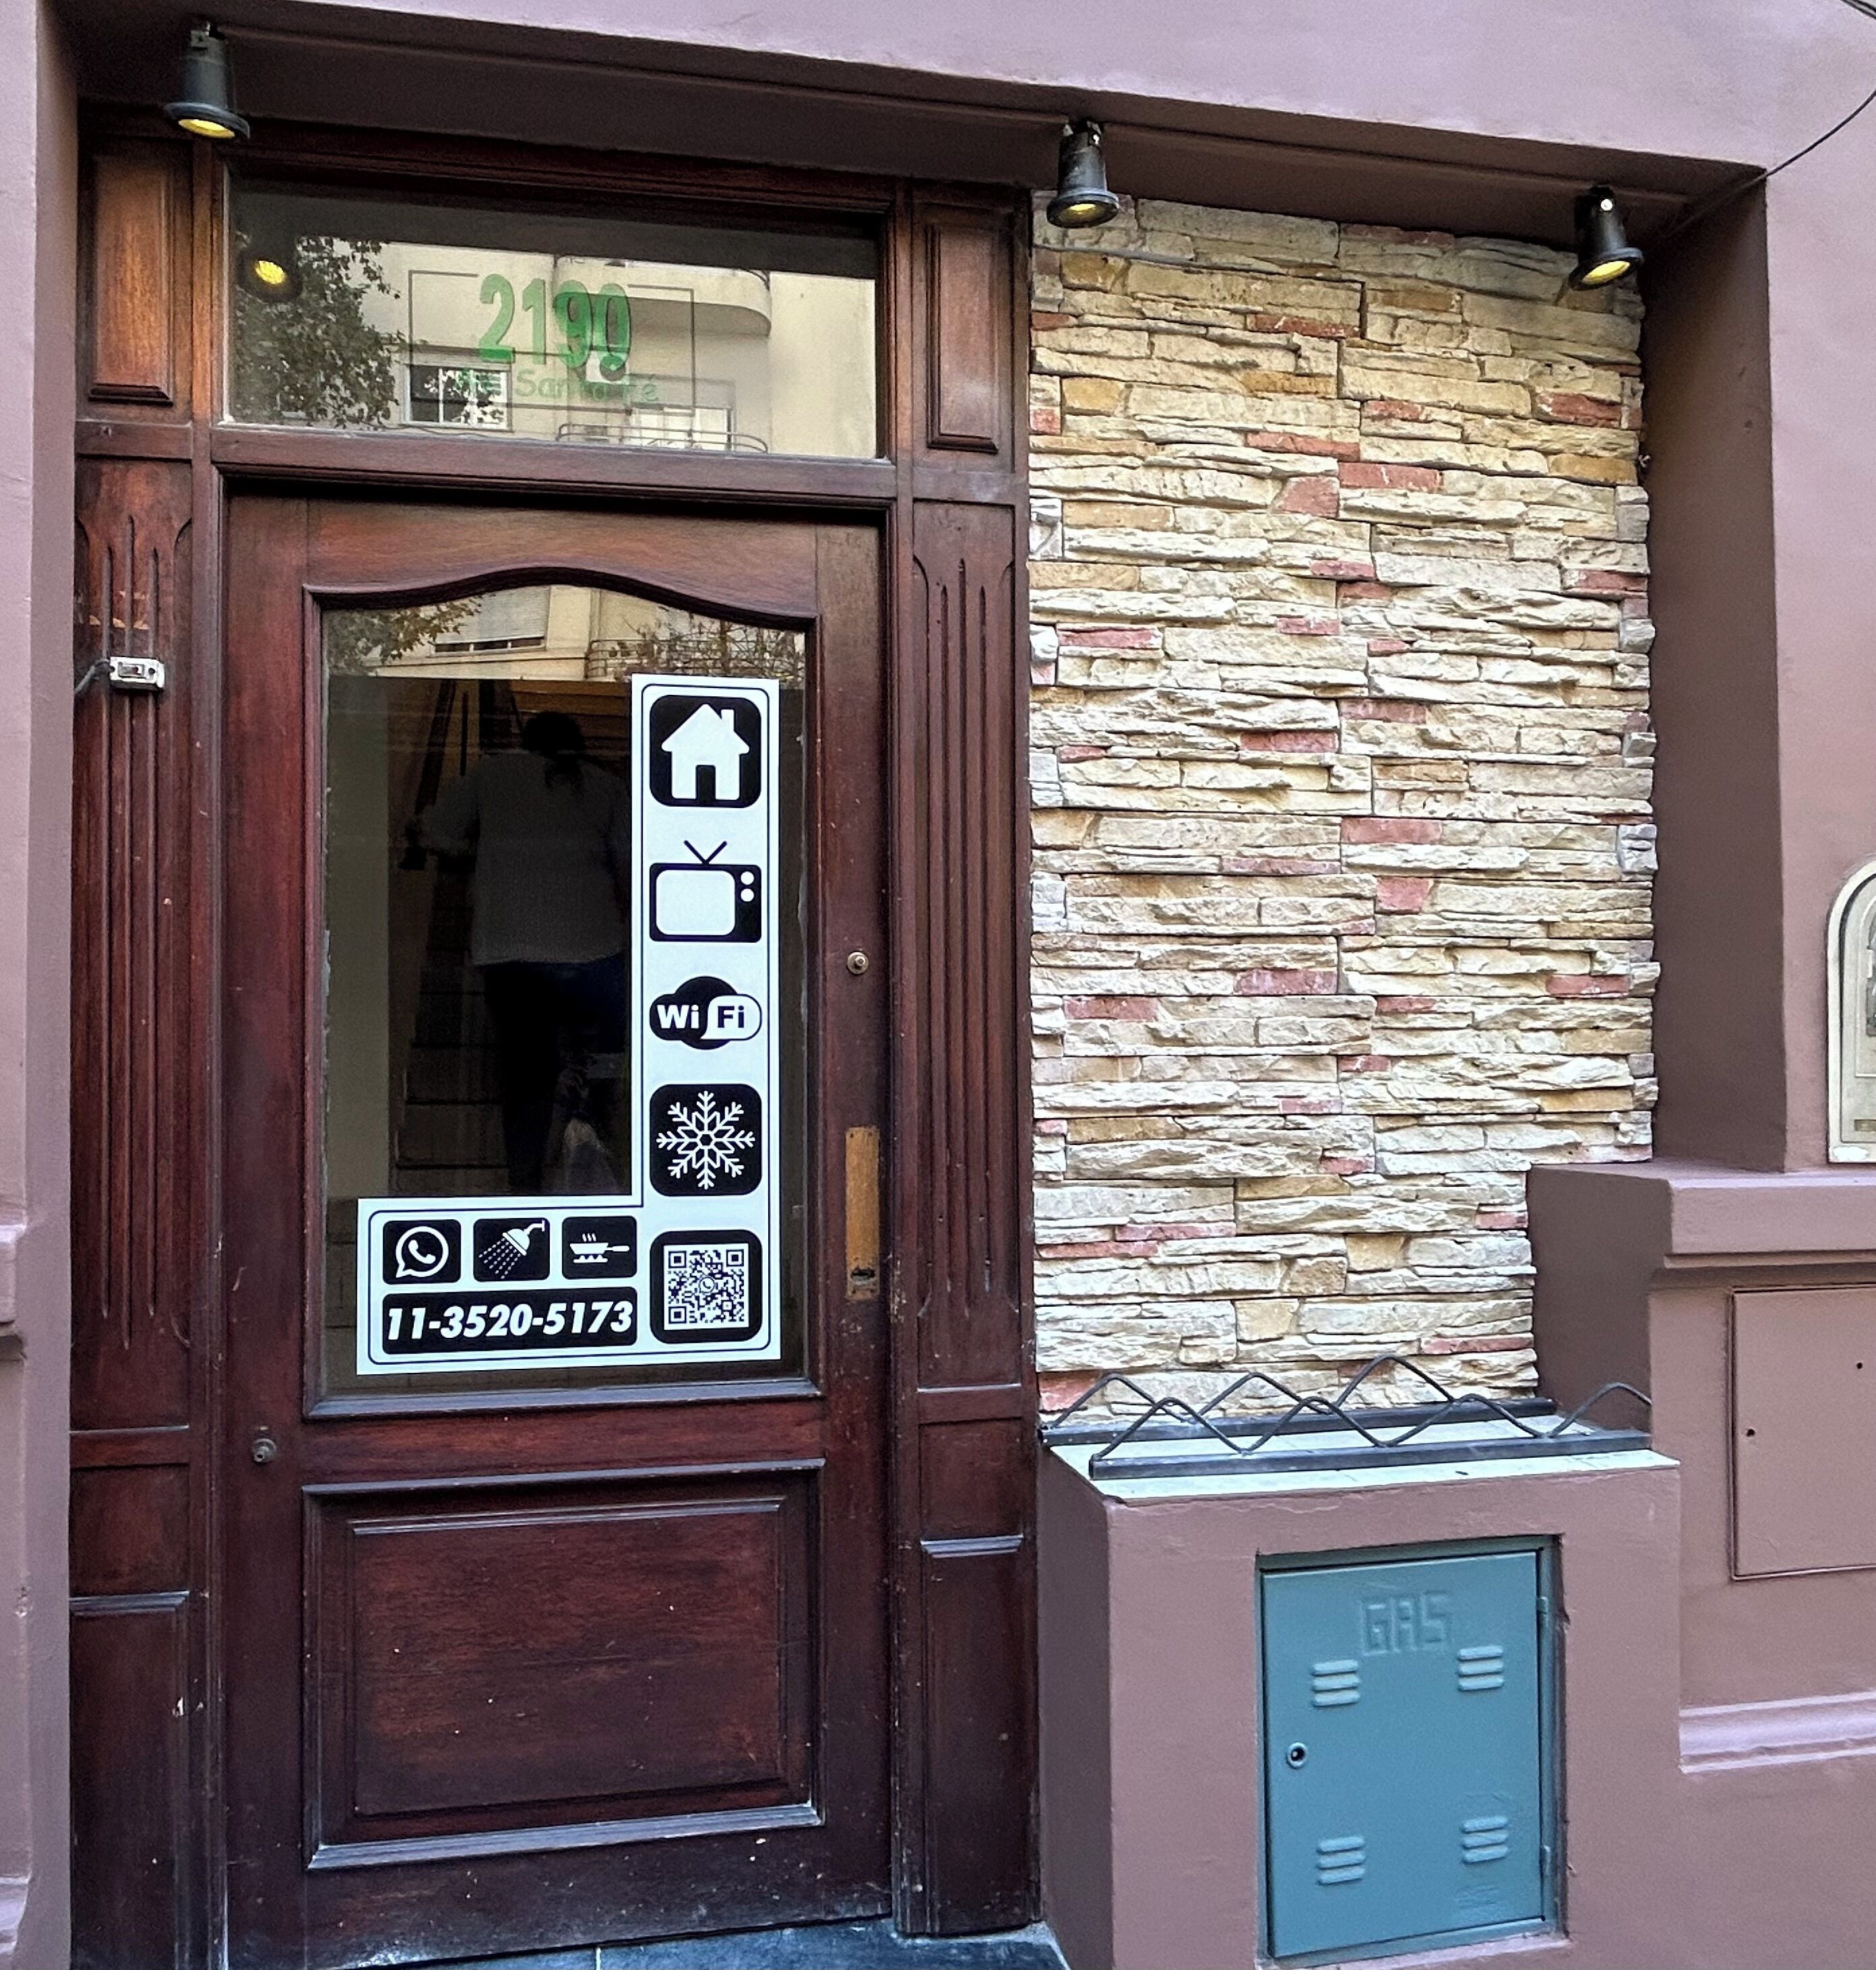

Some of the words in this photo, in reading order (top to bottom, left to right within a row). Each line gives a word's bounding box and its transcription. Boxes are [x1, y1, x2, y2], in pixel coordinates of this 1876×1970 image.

[478, 273, 631, 371] 2190
[387, 1301, 633, 1341] 11-3520-5173
[1359, 1589, 1452, 1656] GAS
